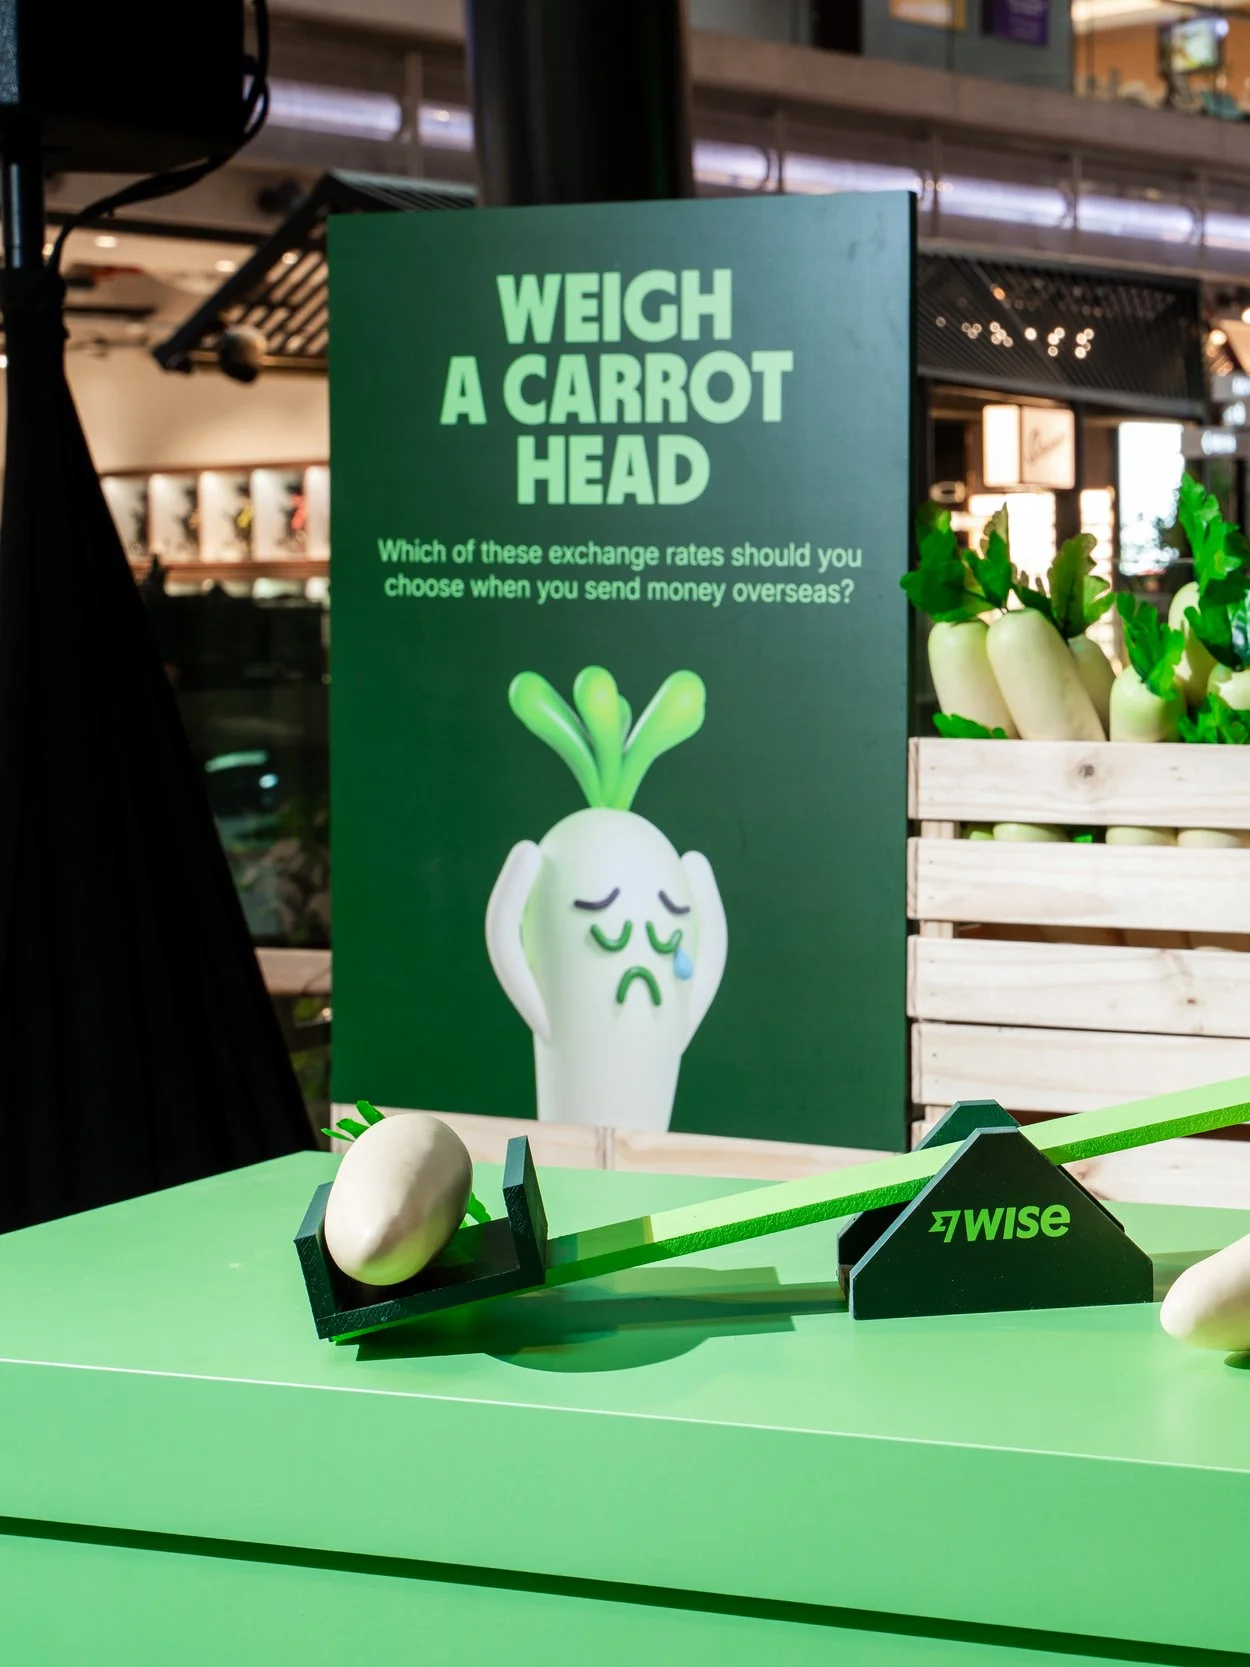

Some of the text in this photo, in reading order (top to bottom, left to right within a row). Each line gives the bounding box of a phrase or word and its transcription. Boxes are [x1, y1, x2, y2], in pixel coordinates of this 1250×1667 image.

[496, 268, 732, 344] WEIGH
[440, 350, 794, 425] A CARROT
[517, 434, 711, 505] HEAD
[377, 538, 862, 573] Which of these exchange rates should you
[384, 573, 855, 608] choose when you send money overseas?
